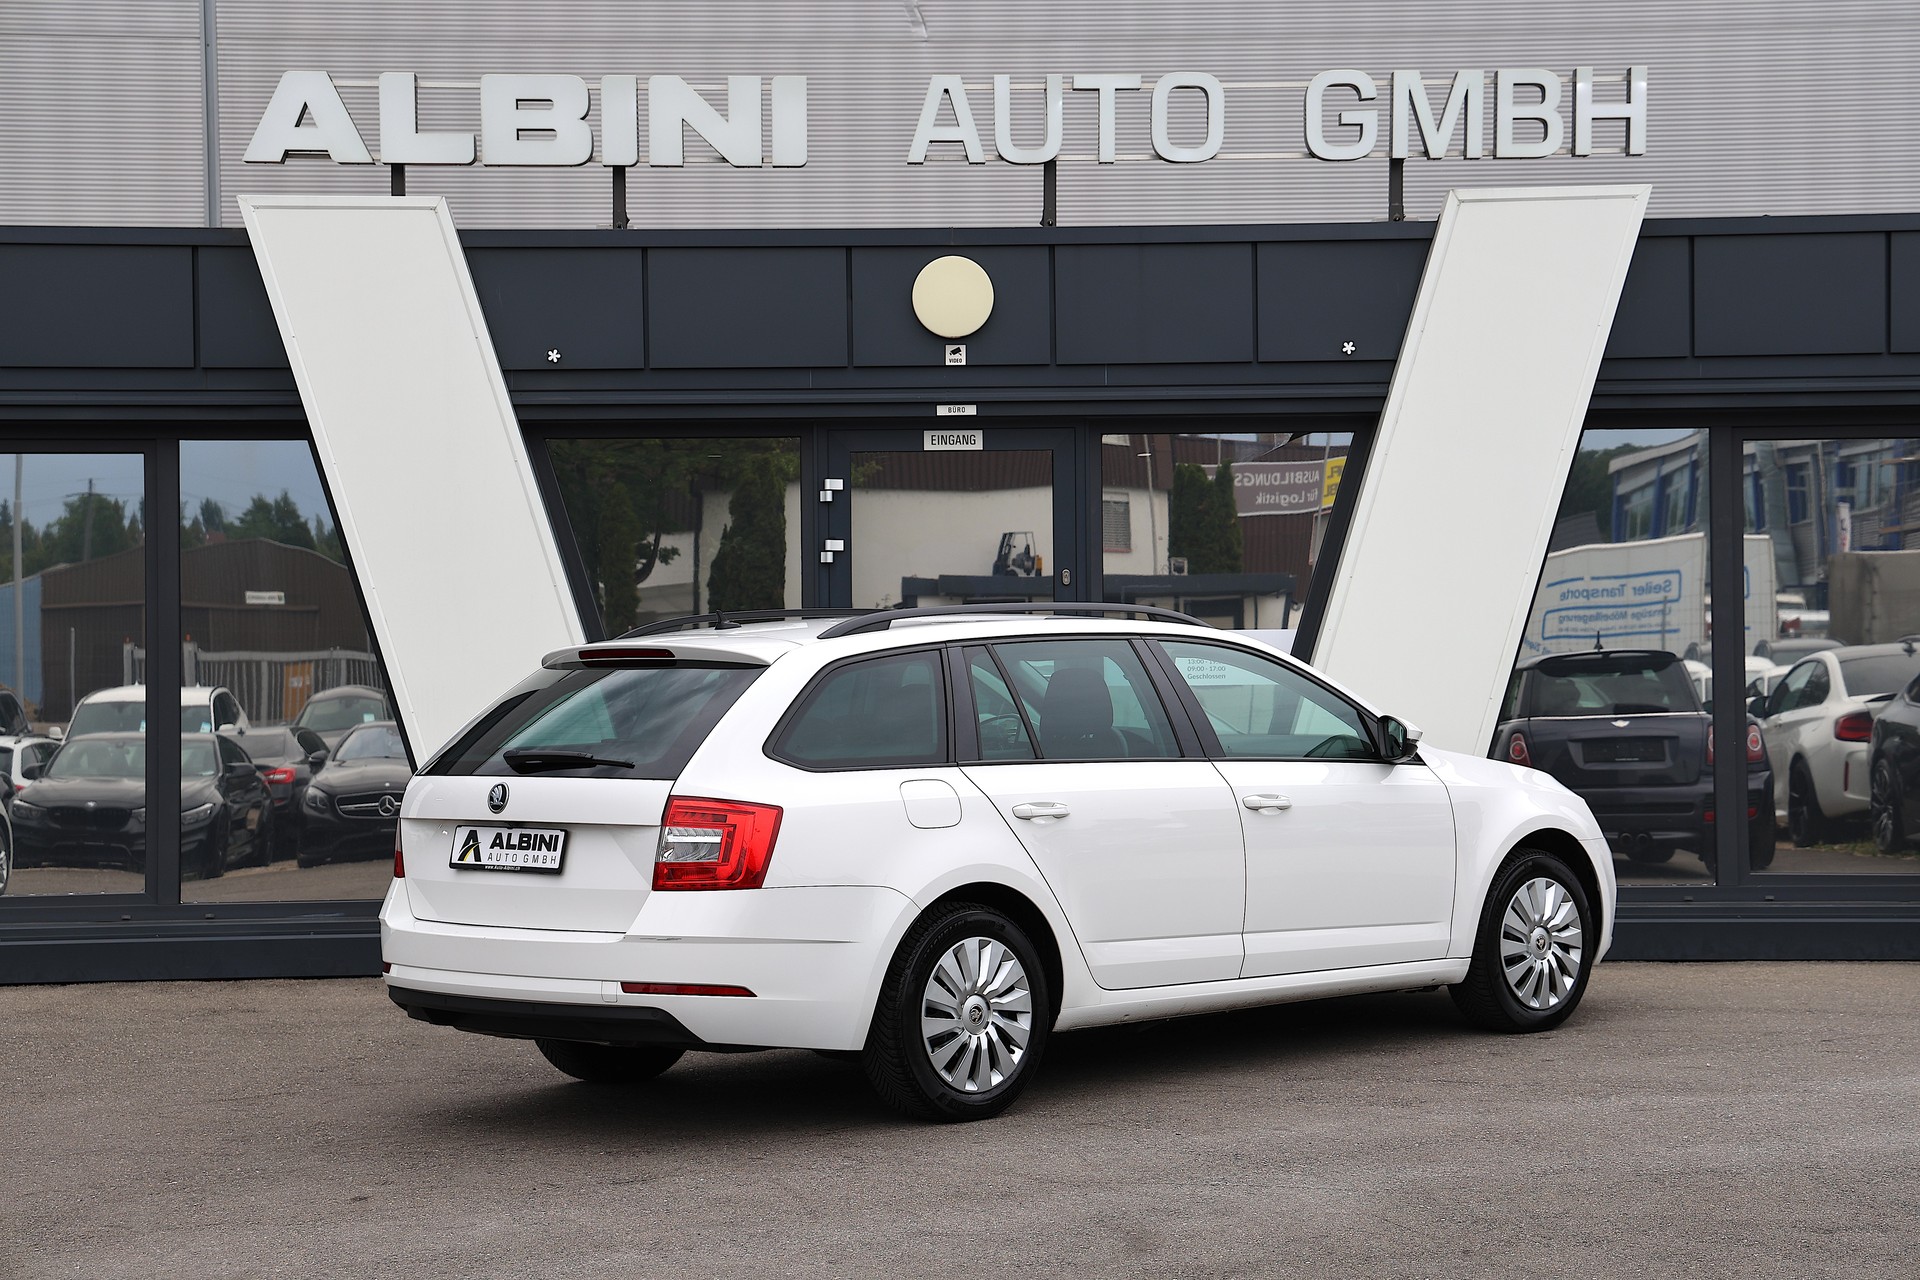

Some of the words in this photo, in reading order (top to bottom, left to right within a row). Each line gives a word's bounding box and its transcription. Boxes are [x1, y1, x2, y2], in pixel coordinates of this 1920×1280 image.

[242, 70, 808, 169] ALBINI
[907, 71, 1226, 165] AUTO
[1303, 66, 1648, 161] GMBH
[947, 405, 966, 414] BÜRO
[930, 434, 977, 446] EINGANG
[489, 831, 560, 852] ALBINI
[487, 852, 518, 863] AUTO
[523, 853, 557, 865] GMBH
